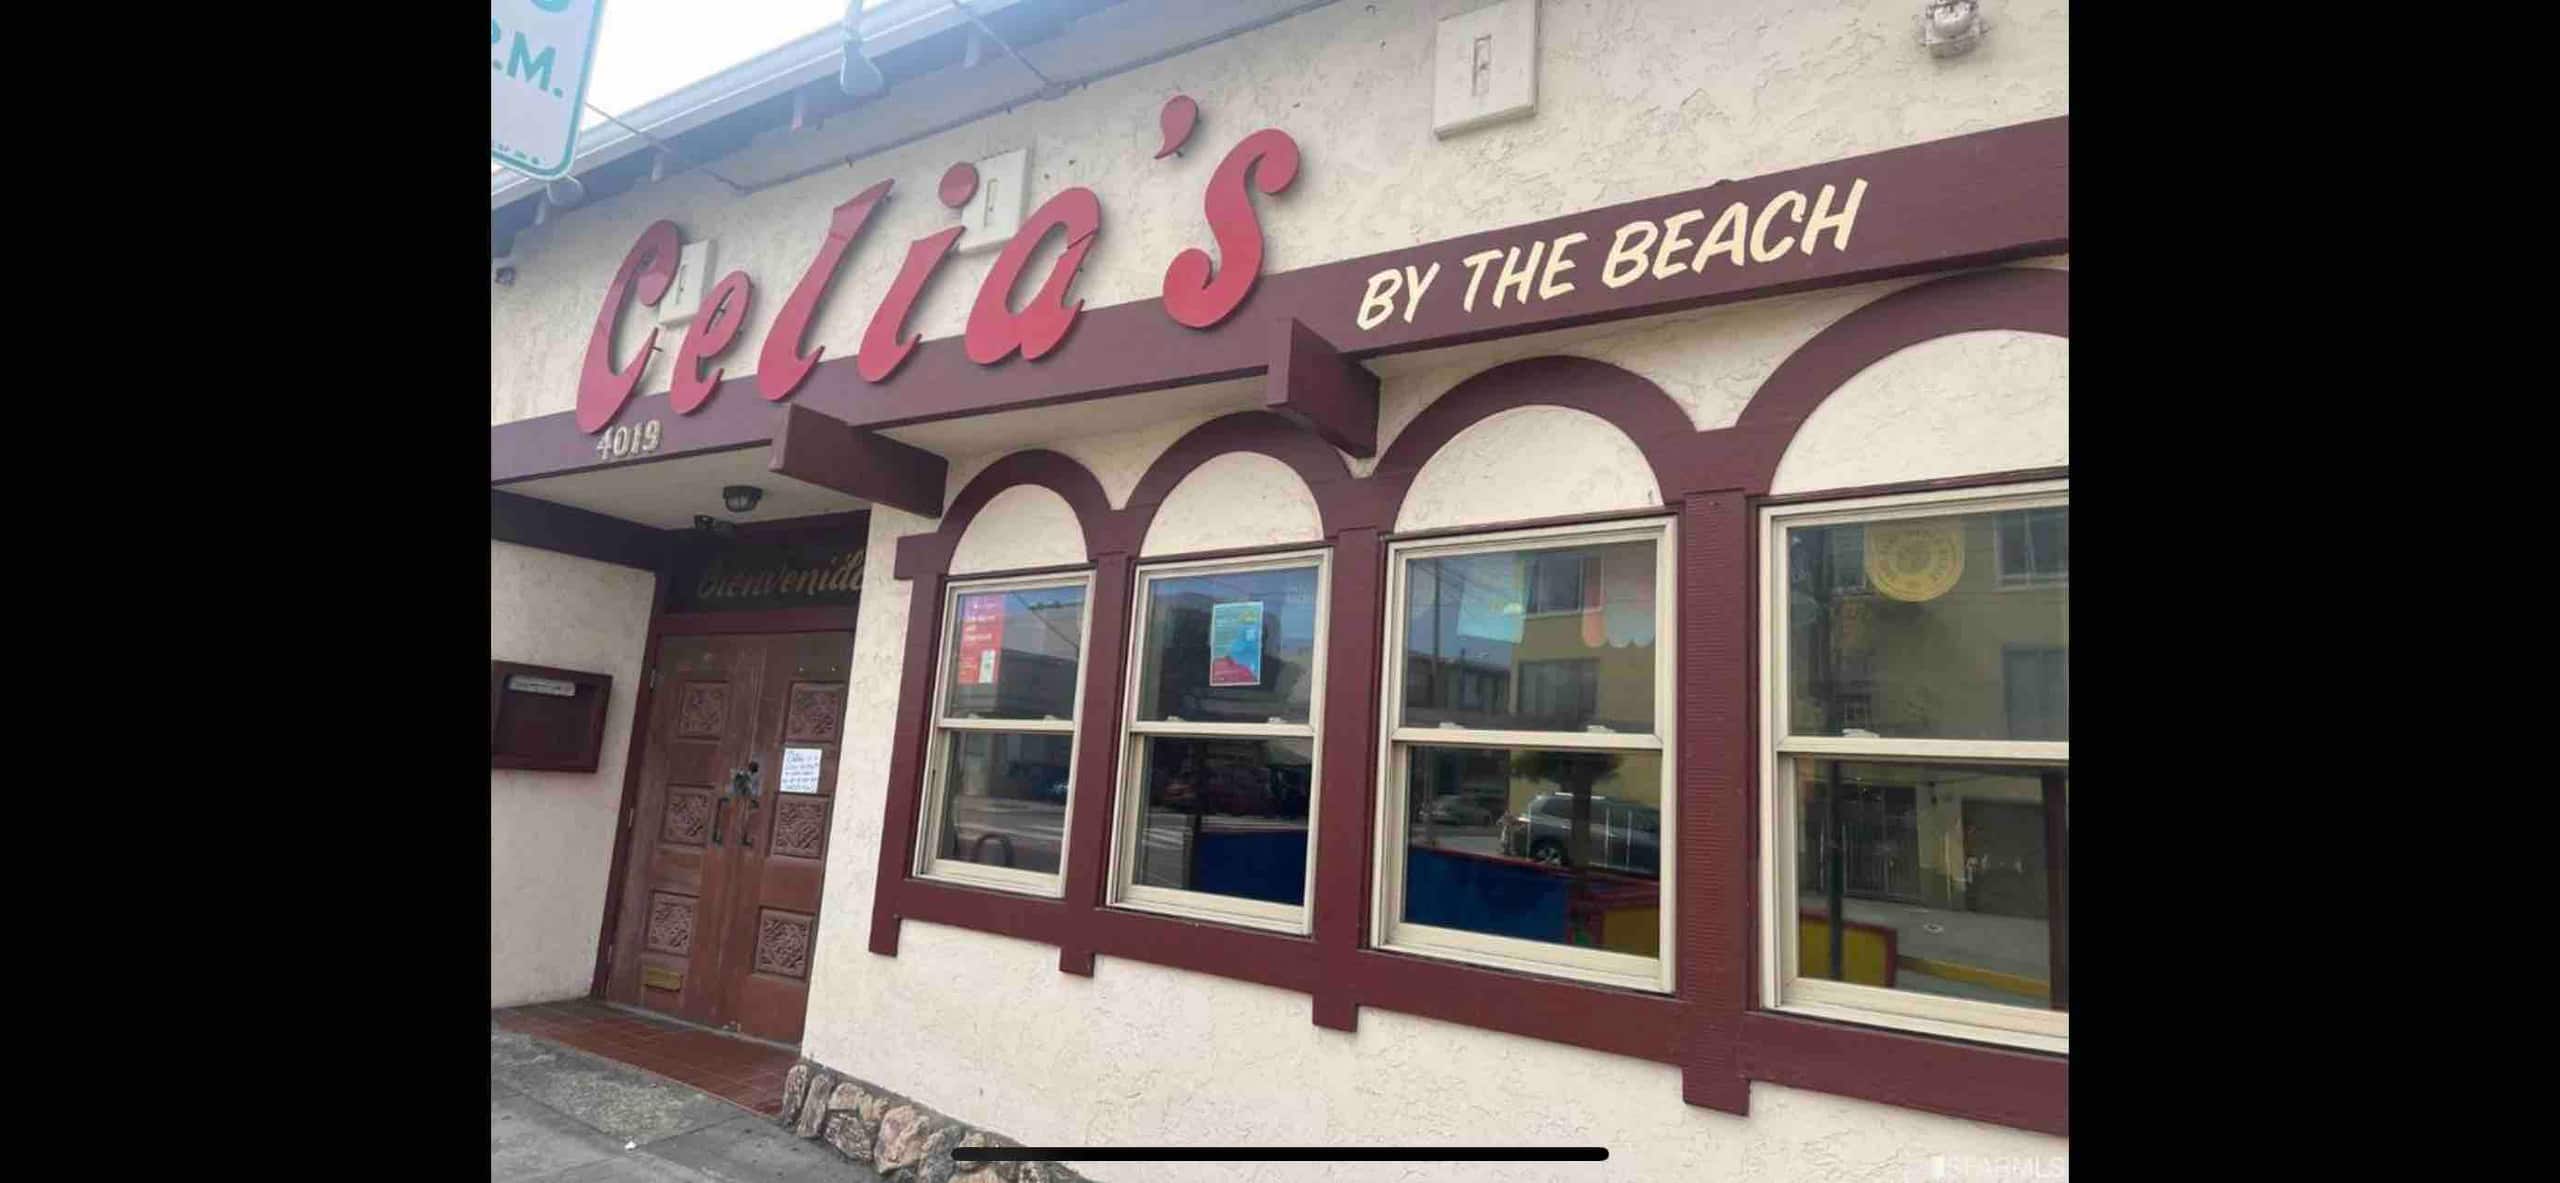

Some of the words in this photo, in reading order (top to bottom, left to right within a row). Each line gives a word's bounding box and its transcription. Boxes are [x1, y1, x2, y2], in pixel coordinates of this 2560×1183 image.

[575, 95, 1300, 434] Celia's
[1357, 262, 1440, 331] BY
[1463, 232, 1588, 313] THE
[1602, 178, 1868, 289] BEACH
[596, 419, 661, 460] 4019
